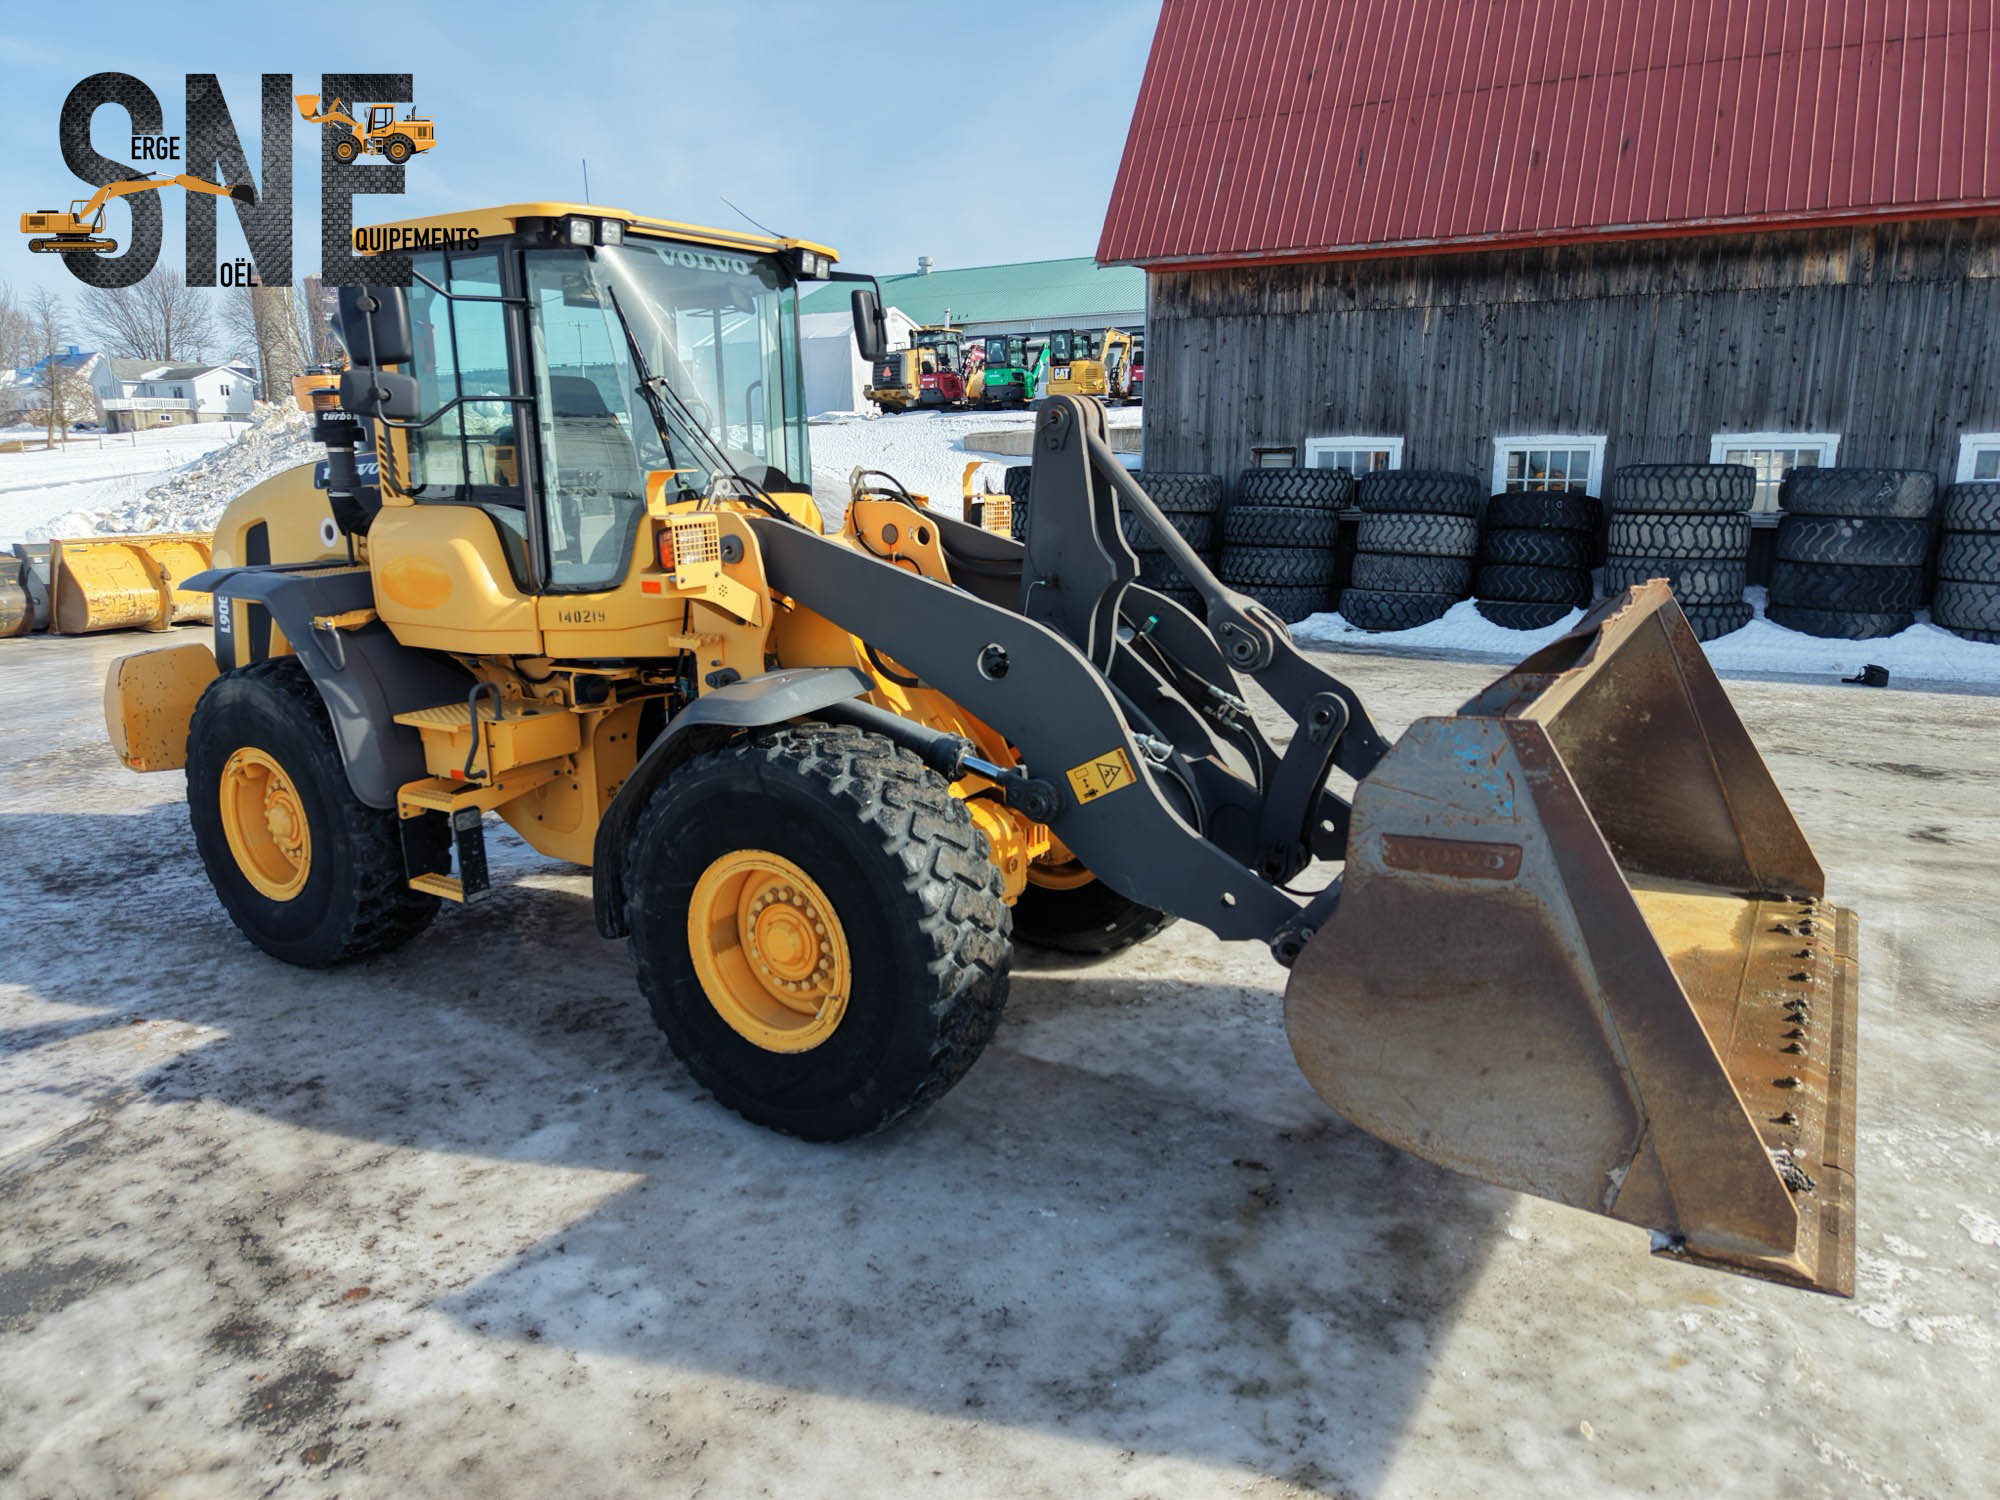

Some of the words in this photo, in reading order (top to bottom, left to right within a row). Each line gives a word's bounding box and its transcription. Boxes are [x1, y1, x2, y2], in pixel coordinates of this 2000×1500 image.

[655, 247, 749, 275] VOLVO
[1054, 368, 1070, 380] CAT
[218, 595, 231, 634] L90E
[558, 609, 605, 623] 140219
